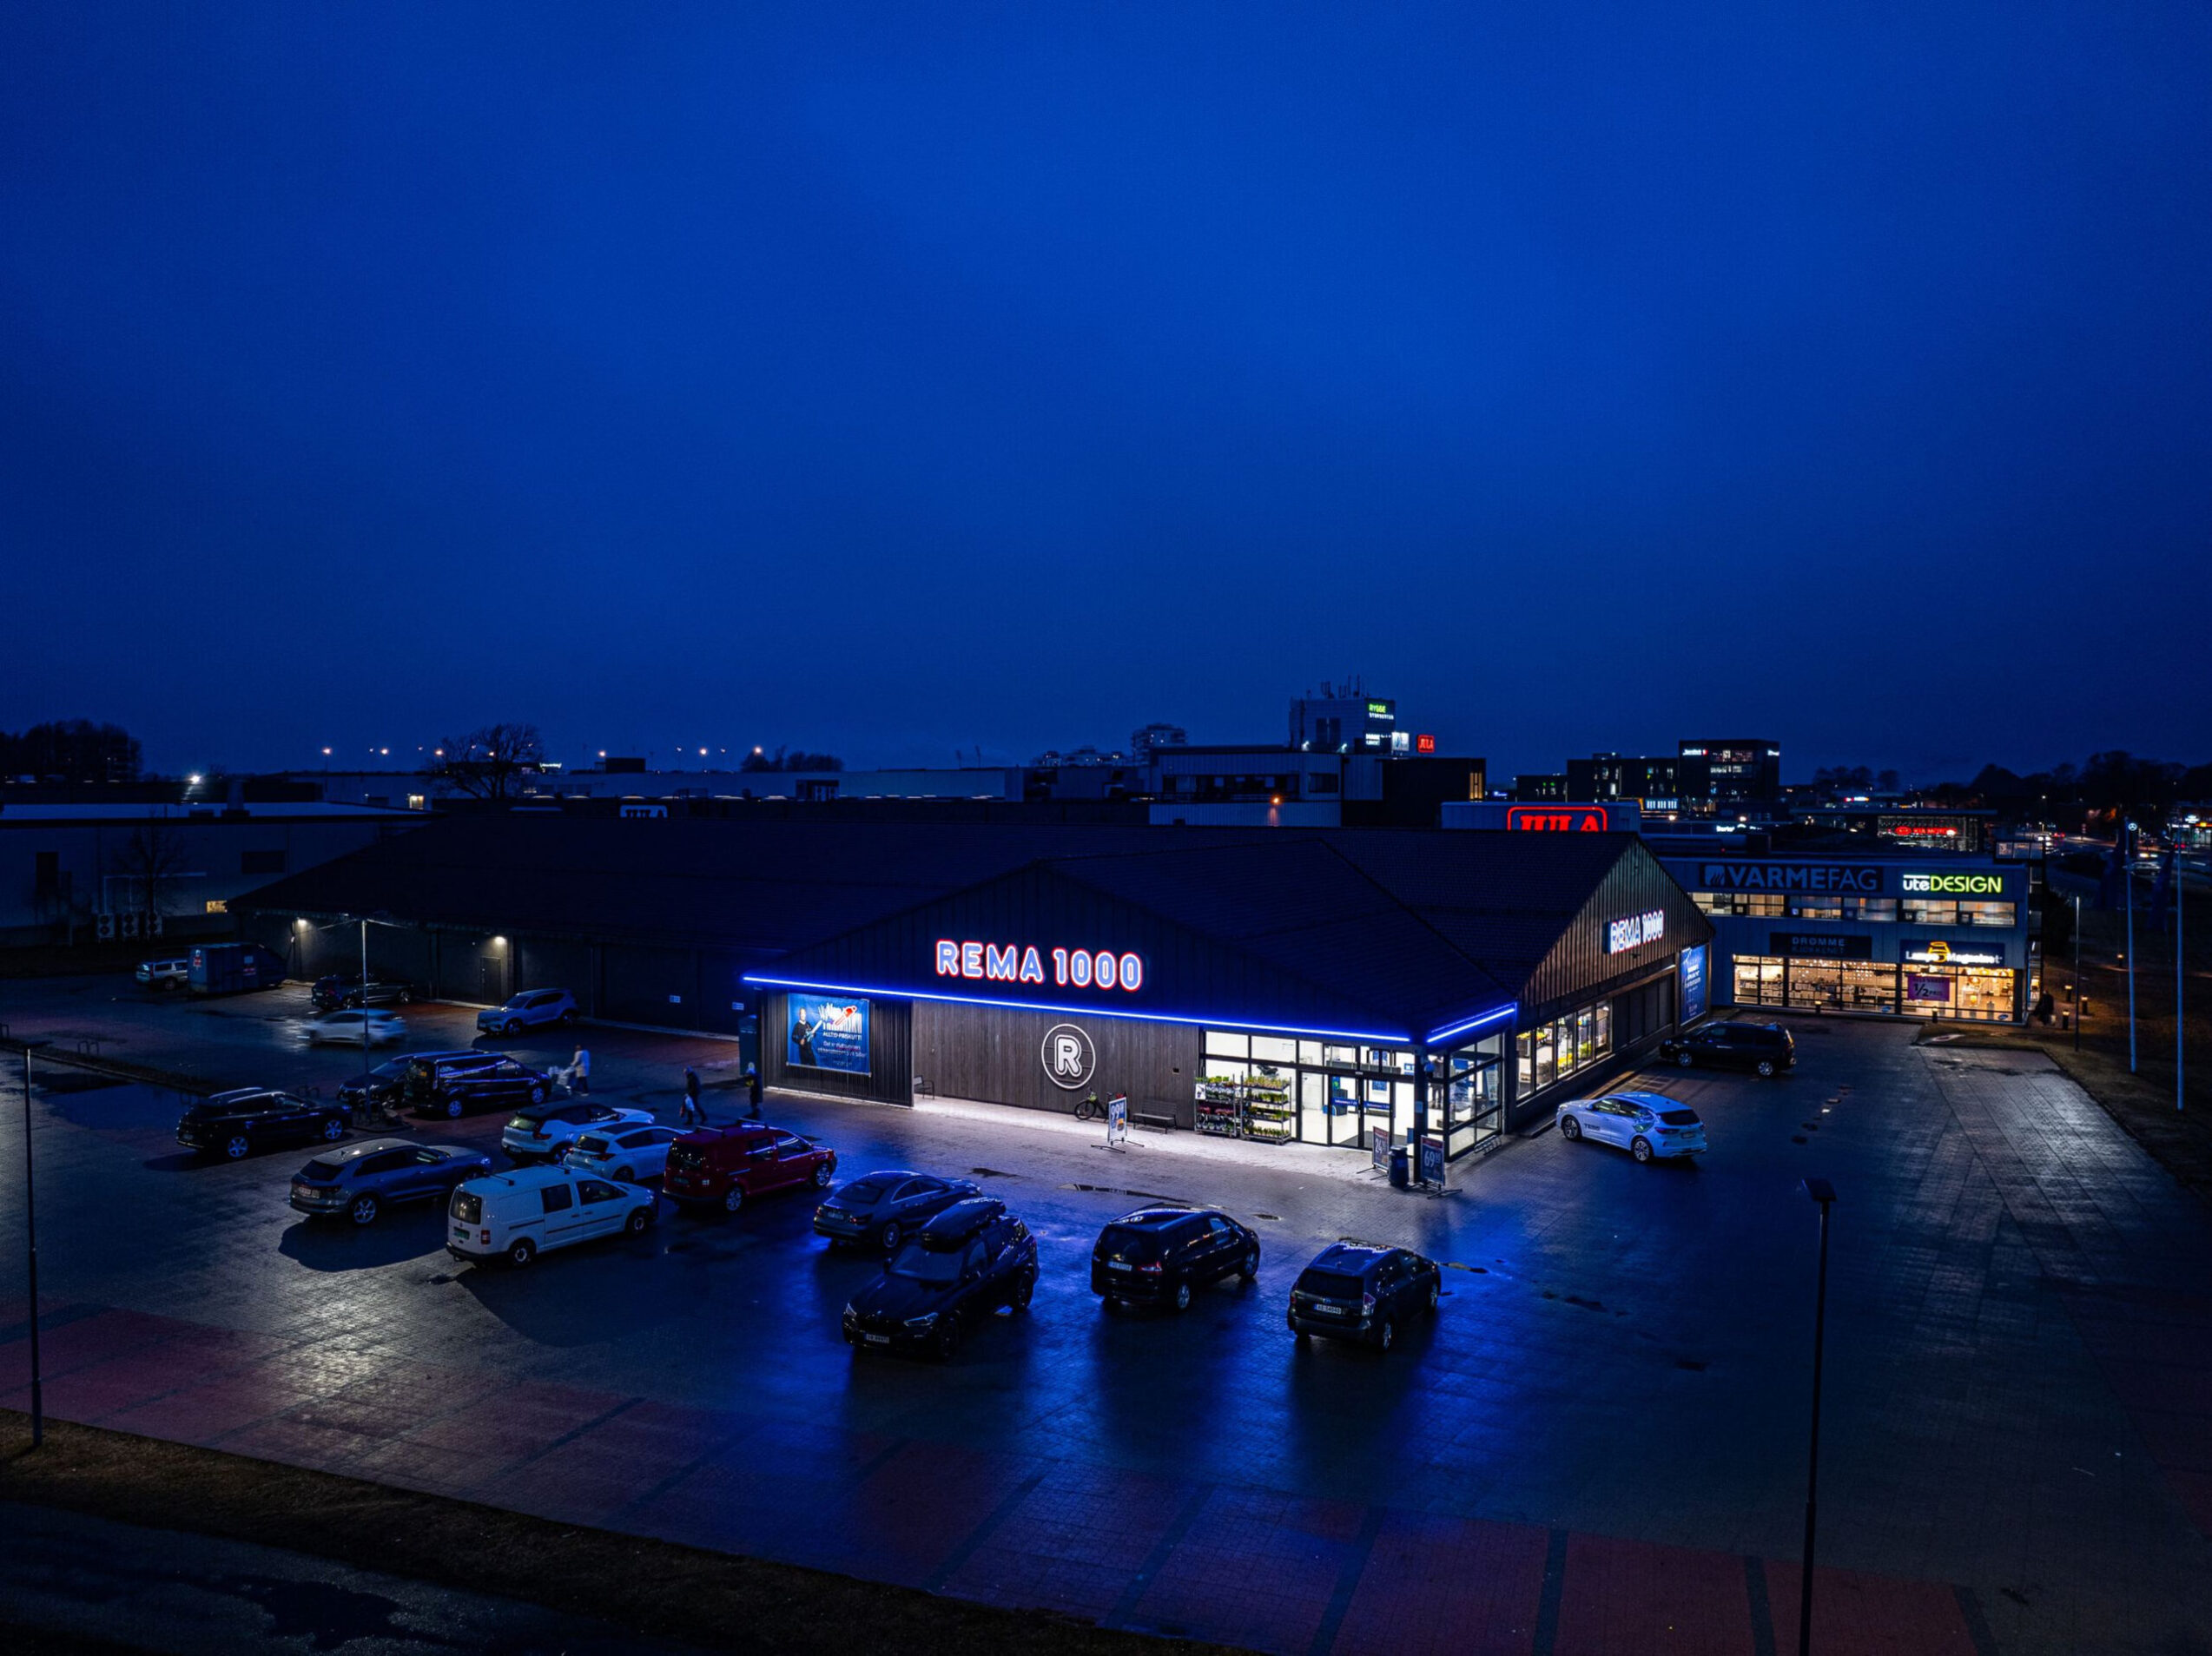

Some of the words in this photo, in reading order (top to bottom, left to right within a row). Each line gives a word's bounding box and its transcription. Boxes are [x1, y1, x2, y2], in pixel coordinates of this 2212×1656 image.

[1727, 865, 1878, 891] VARMEFAG
[1611, 915, 1641, 954] REMA
[1642, 909, 1664, 945] 1000
[936, 939, 1045, 985] REMA
[1052, 947, 1144, 992] 1000
[1054, 1033, 1082, 1077] R
